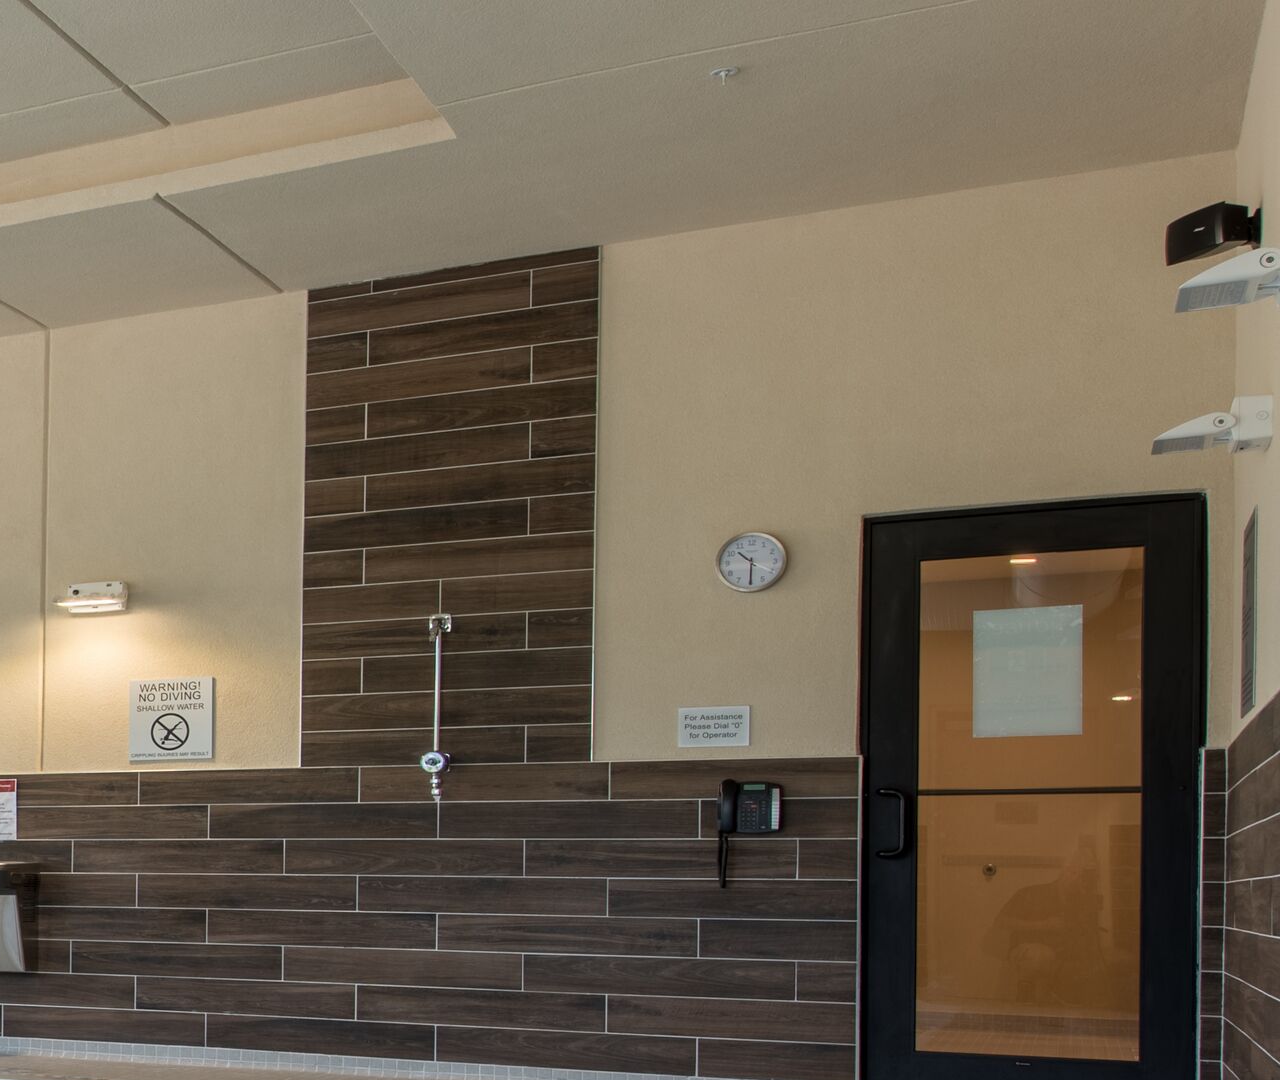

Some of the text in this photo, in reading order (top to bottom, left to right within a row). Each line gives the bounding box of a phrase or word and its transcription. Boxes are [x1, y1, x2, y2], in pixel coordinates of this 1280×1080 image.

[140, 681, 201, 692] WARNING!
[138, 691, 201, 702] NO DIVING
